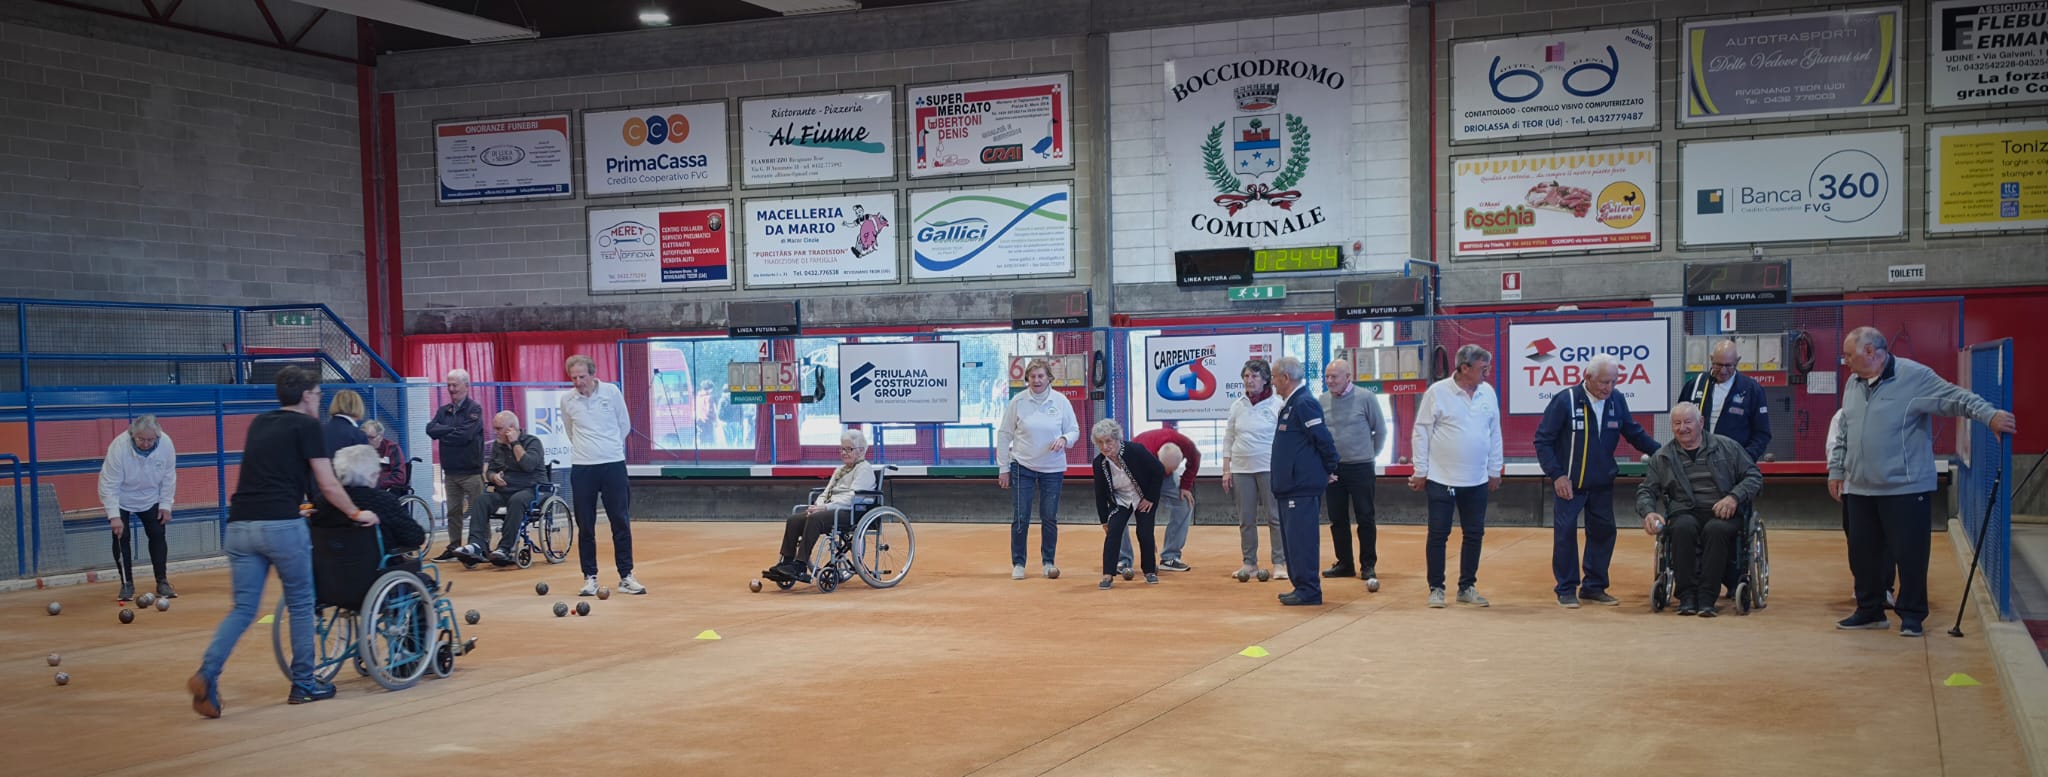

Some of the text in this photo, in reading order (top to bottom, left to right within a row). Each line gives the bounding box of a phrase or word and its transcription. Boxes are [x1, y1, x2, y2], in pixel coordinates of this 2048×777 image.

[1978, 12, 2048, 30] FLEBU
[1632, 28, 1653, 41] chiuso
[1726, 29, 1856, 47] AUTOTRASPORTI
[1708, 56, 1746, 72] Delle
[1750, 50, 1798, 70] Vedove
[1800, 48, 1852, 69] Gianni
[1946, 54, 1974, 62] UDINE
[1172, 59, 1344, 102] BOCCIODROMO
[1978, 74, 1999, 84] La
[1736, 86, 1790, 96] RIVIGNANO
[1957, 85, 2019, 100] grande
[926, 92, 963, 106] SUPER
[771, 102, 864, 118] Ristorante Pizzeria
[938, 102, 991, 116] MERCATO
[1465, 107, 1516, 118] CONTATTOLOGO
[1522, 104, 1559, 114] CONTROLLO
[1585, 98, 1644, 109] COMPUTERIZZATO
[465, 121, 538, 133] ONORANZE FUNEBRI
[939, 114, 982, 128] BERTONI
[1464, 112, 1643, 133] DRIOLASSA di TEOR (Ud) Tel. 0432779487
[769, 121, 870, 147] Al Fiume
[939, 128, 969, 140] DENIS
[983, 146, 1021, 162] CRAI
[606, 154, 707, 173] PrimaCassa
[2002, 158, 2029, 167] targhe
[607, 175, 637, 186] Credito
[639, 172, 688, 185] Cooperativo
[2002, 169, 2033, 178] stampe
[1742, 172, 1879, 205] Banca 360
[757, 208, 843, 221] MACELLERIA
[1804, 203, 1831, 213] FVG
[1191, 206, 1326, 238] COMUNALE
[1465, 205, 1534, 227] foschia
[611, 226, 644, 236] MERET
[765, 223, 835, 236] DA MARIO
[917, 224, 989, 243] Gallici
[1890, 268, 1924, 278] TOILETTE
[1724, 311, 1731, 328] 1
[1373, 324, 1383, 340] 2
[759, 342, 767, 357] 4
[1038, 336, 1046, 350] 3
[1154, 348, 1215, 370] CARPENTERIE
[780, 363, 792, 384] 5
[874, 369, 928, 378] FRIULANA
[1010, 357, 1024, 379] 6
[1523, 364, 1651, 387] TABGA
[874, 379, 948, 388] COSTRUZIONI
[874, 388, 911, 398] GROUP
